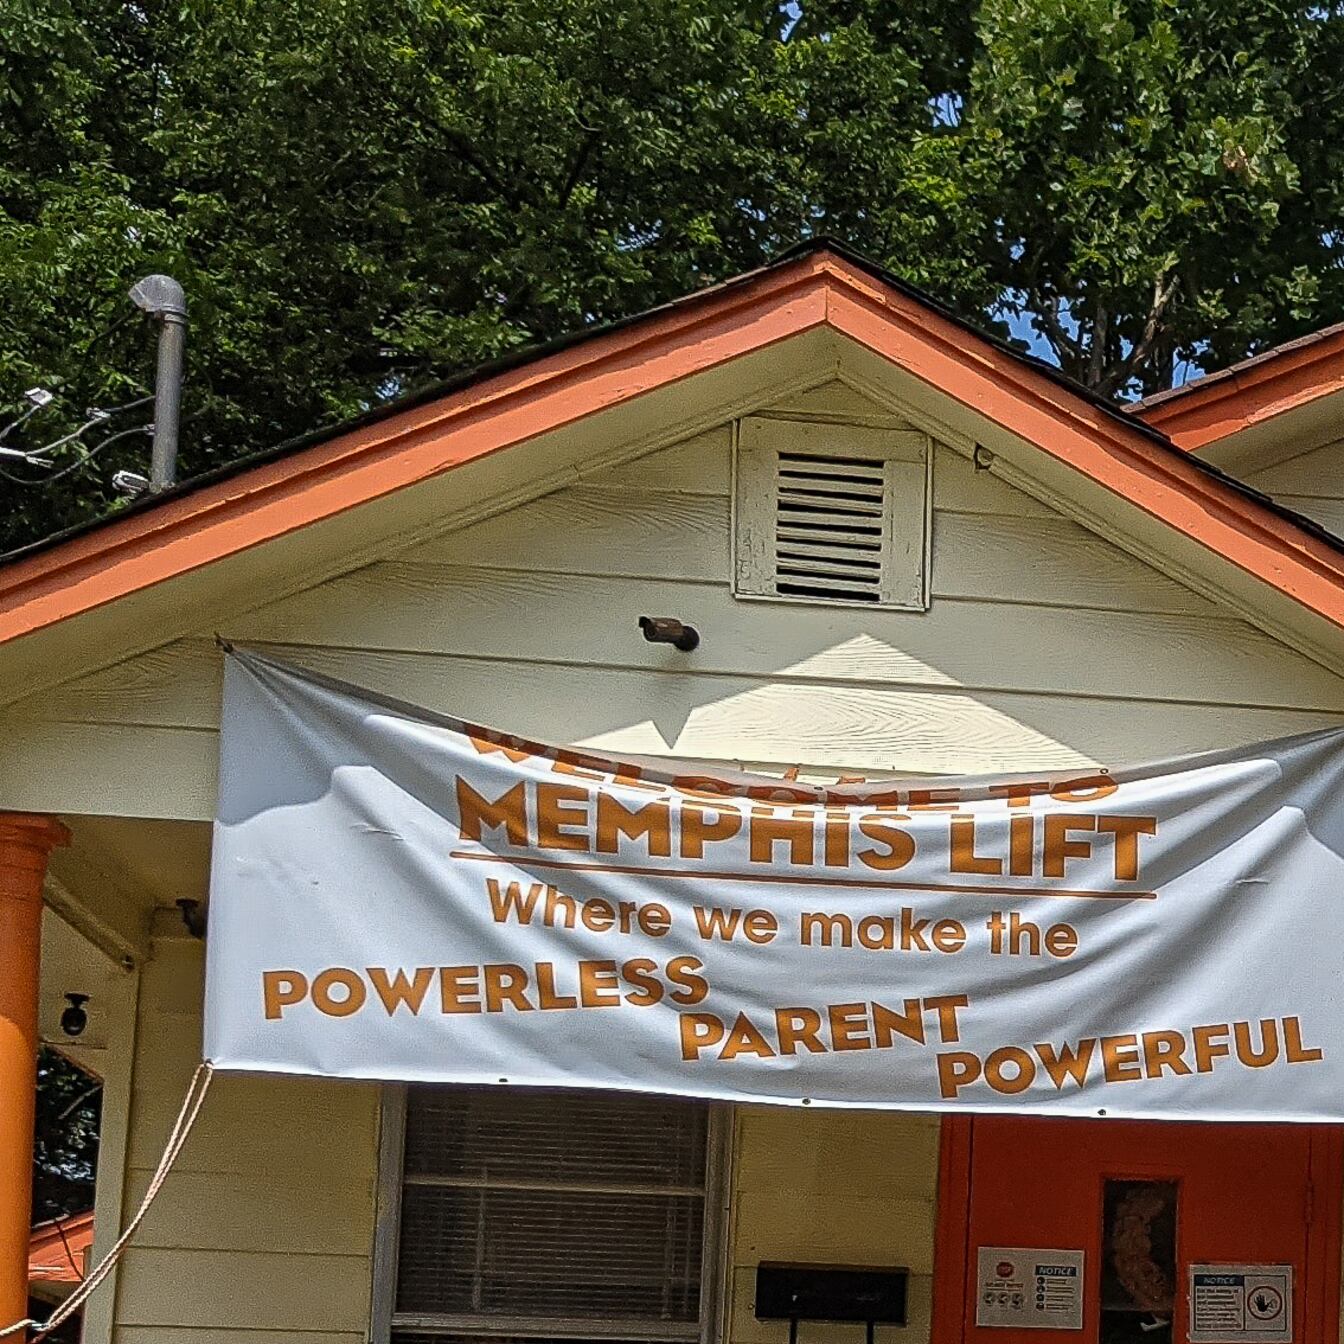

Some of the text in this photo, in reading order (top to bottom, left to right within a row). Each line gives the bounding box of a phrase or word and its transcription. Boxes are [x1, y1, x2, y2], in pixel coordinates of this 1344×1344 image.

[456, 775, 1158, 881] MEMPHIS LIFT
[486, 879, 1078, 958] Where we make the
[263, 956, 709, 1020] POWERLESS
[678, 995, 968, 1061] PARENT
[937, 1017, 1323, 1098] POWERFUL
